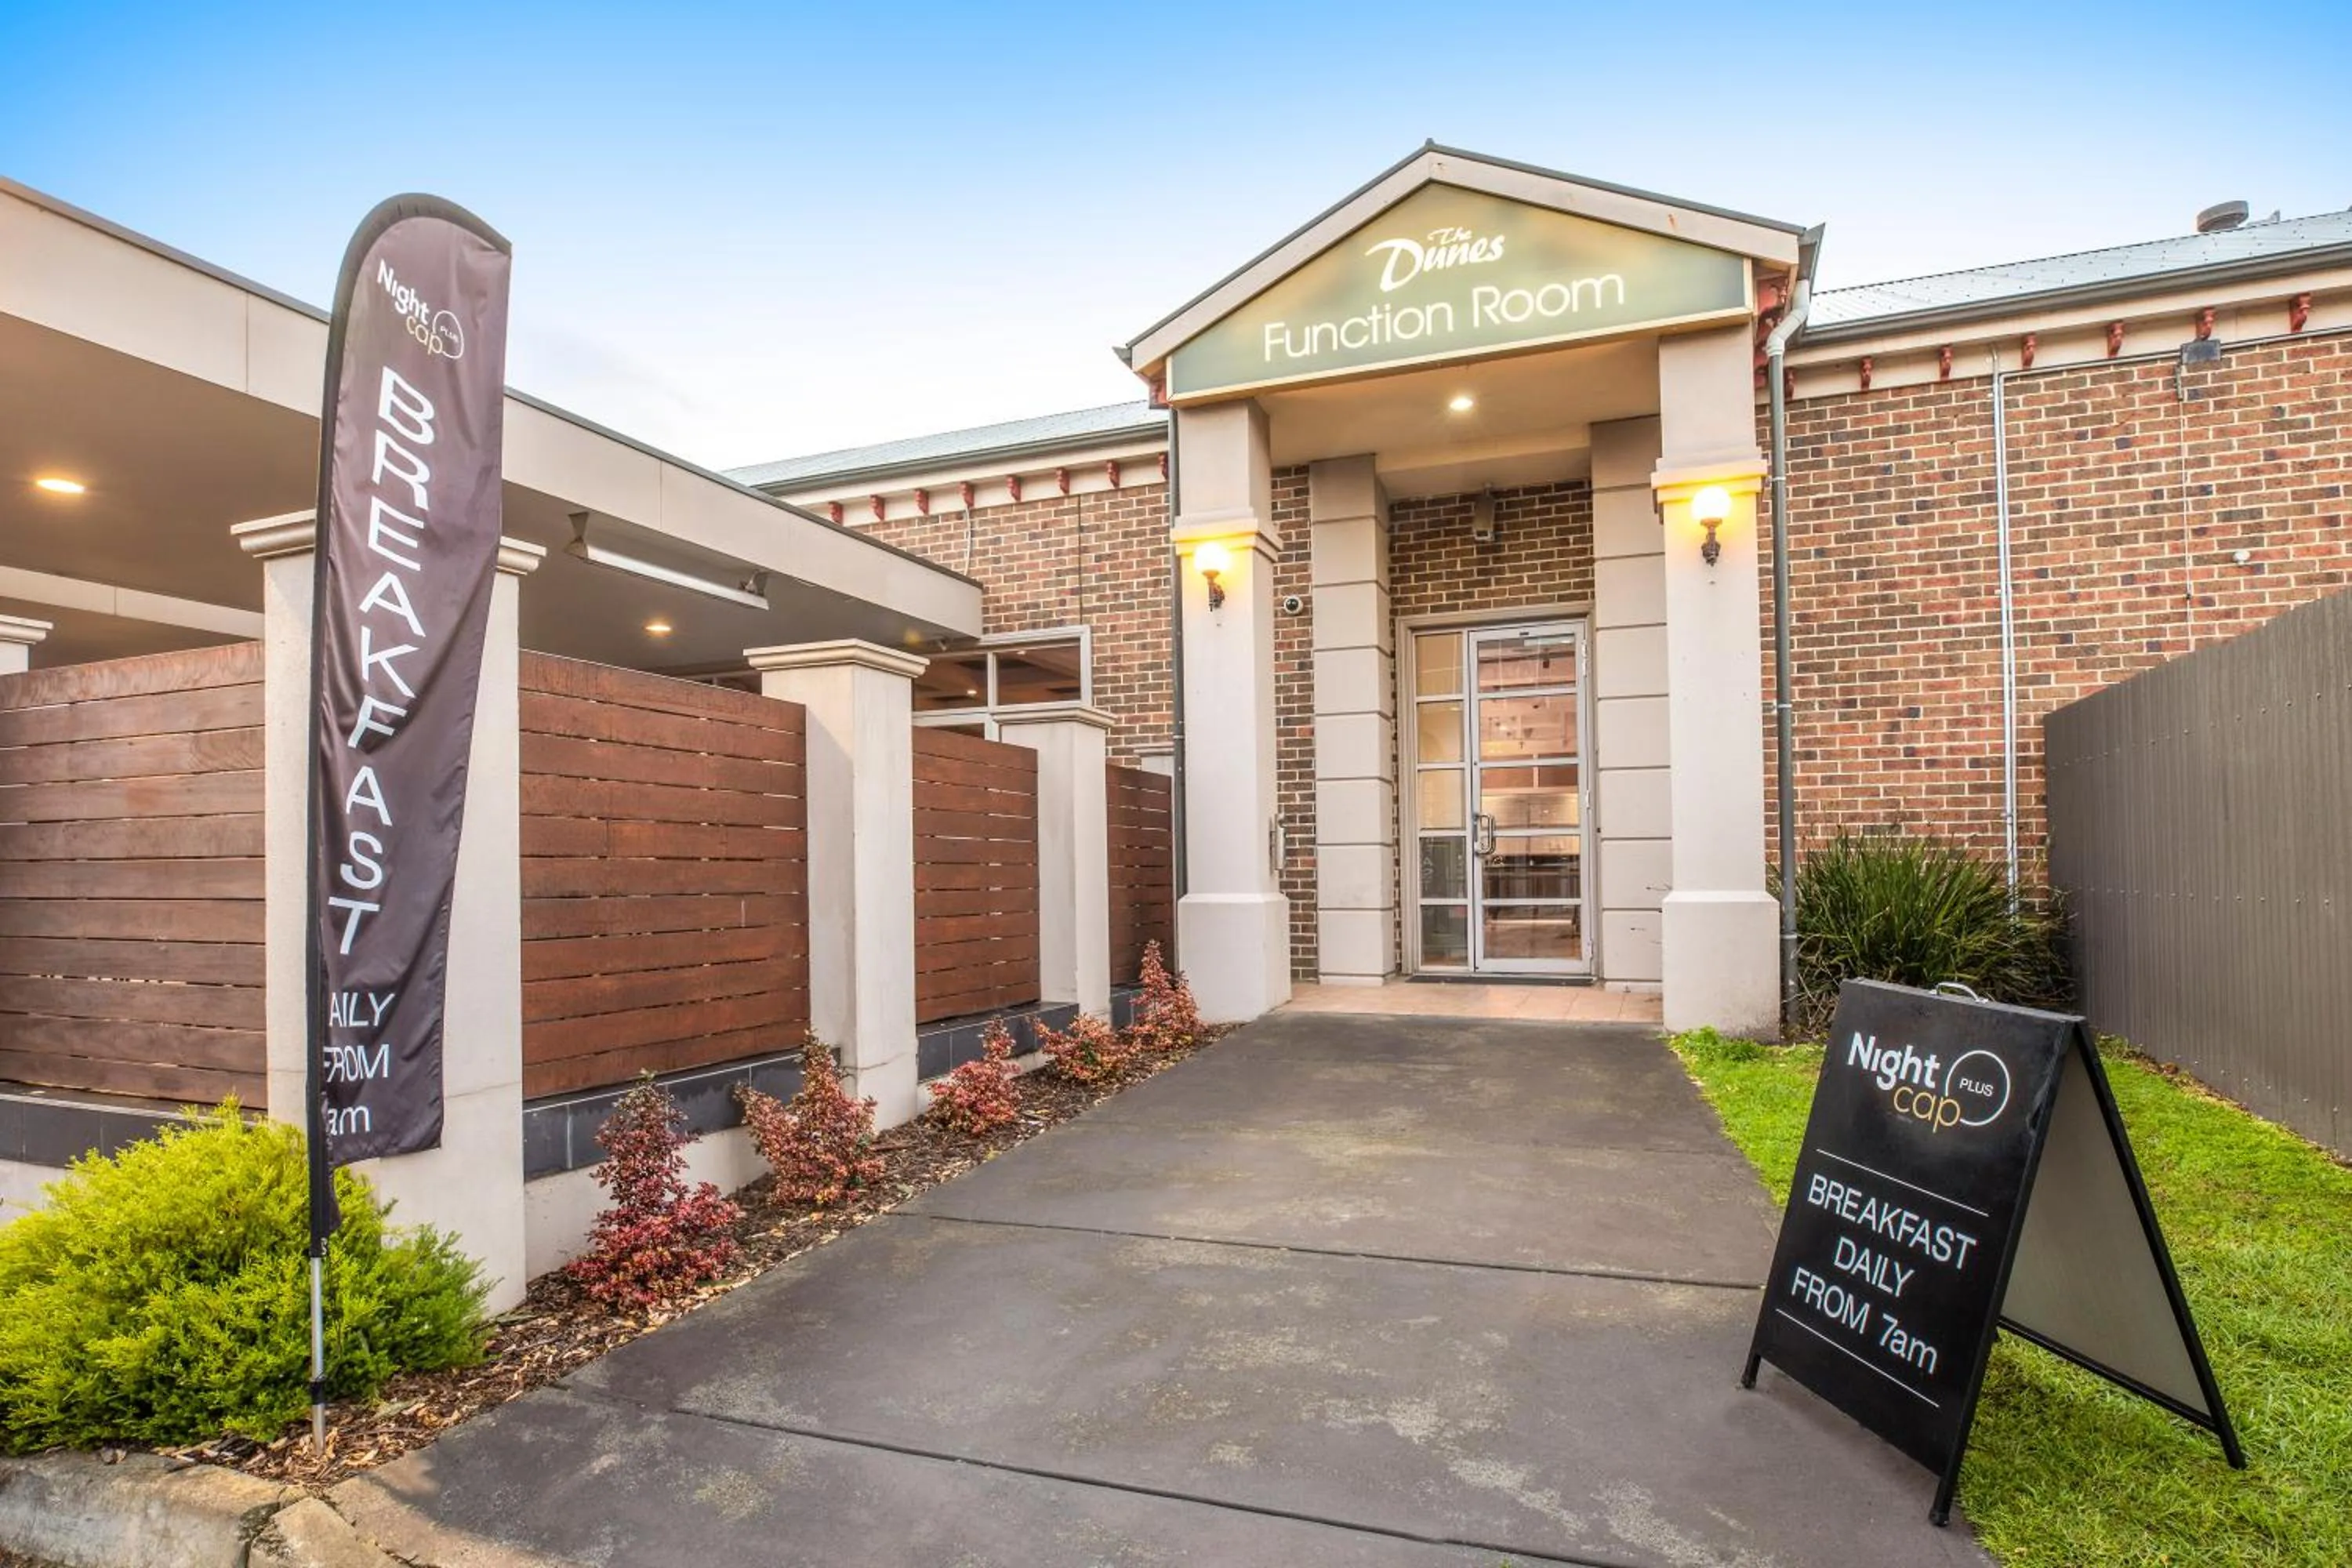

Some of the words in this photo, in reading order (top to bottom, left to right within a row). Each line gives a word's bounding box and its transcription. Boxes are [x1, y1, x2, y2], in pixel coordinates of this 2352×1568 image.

[377, 259, 430, 325] Night
[1364, 235, 1505, 292] Dunes
[406, 315, 443, 354] cap
[1265, 301, 1454, 361] Function
[1472, 273, 1624, 328] Room
[328, 365, 436, 954] BREAKFAST
[328, 991, 395, 1027] AILY
[1847, 1031, 1940, 1091] Night
[1959, 1078, 1994, 1097] PLUS
[1893, 1087, 1961, 1134] cap
[1808, 1174, 1976, 1269] BREAKFAST
[1835, 1236, 1915, 1298] DAILY
[1791, 1268, 1871, 1334] FROM
[1878, 1313, 1939, 1375] 7am
